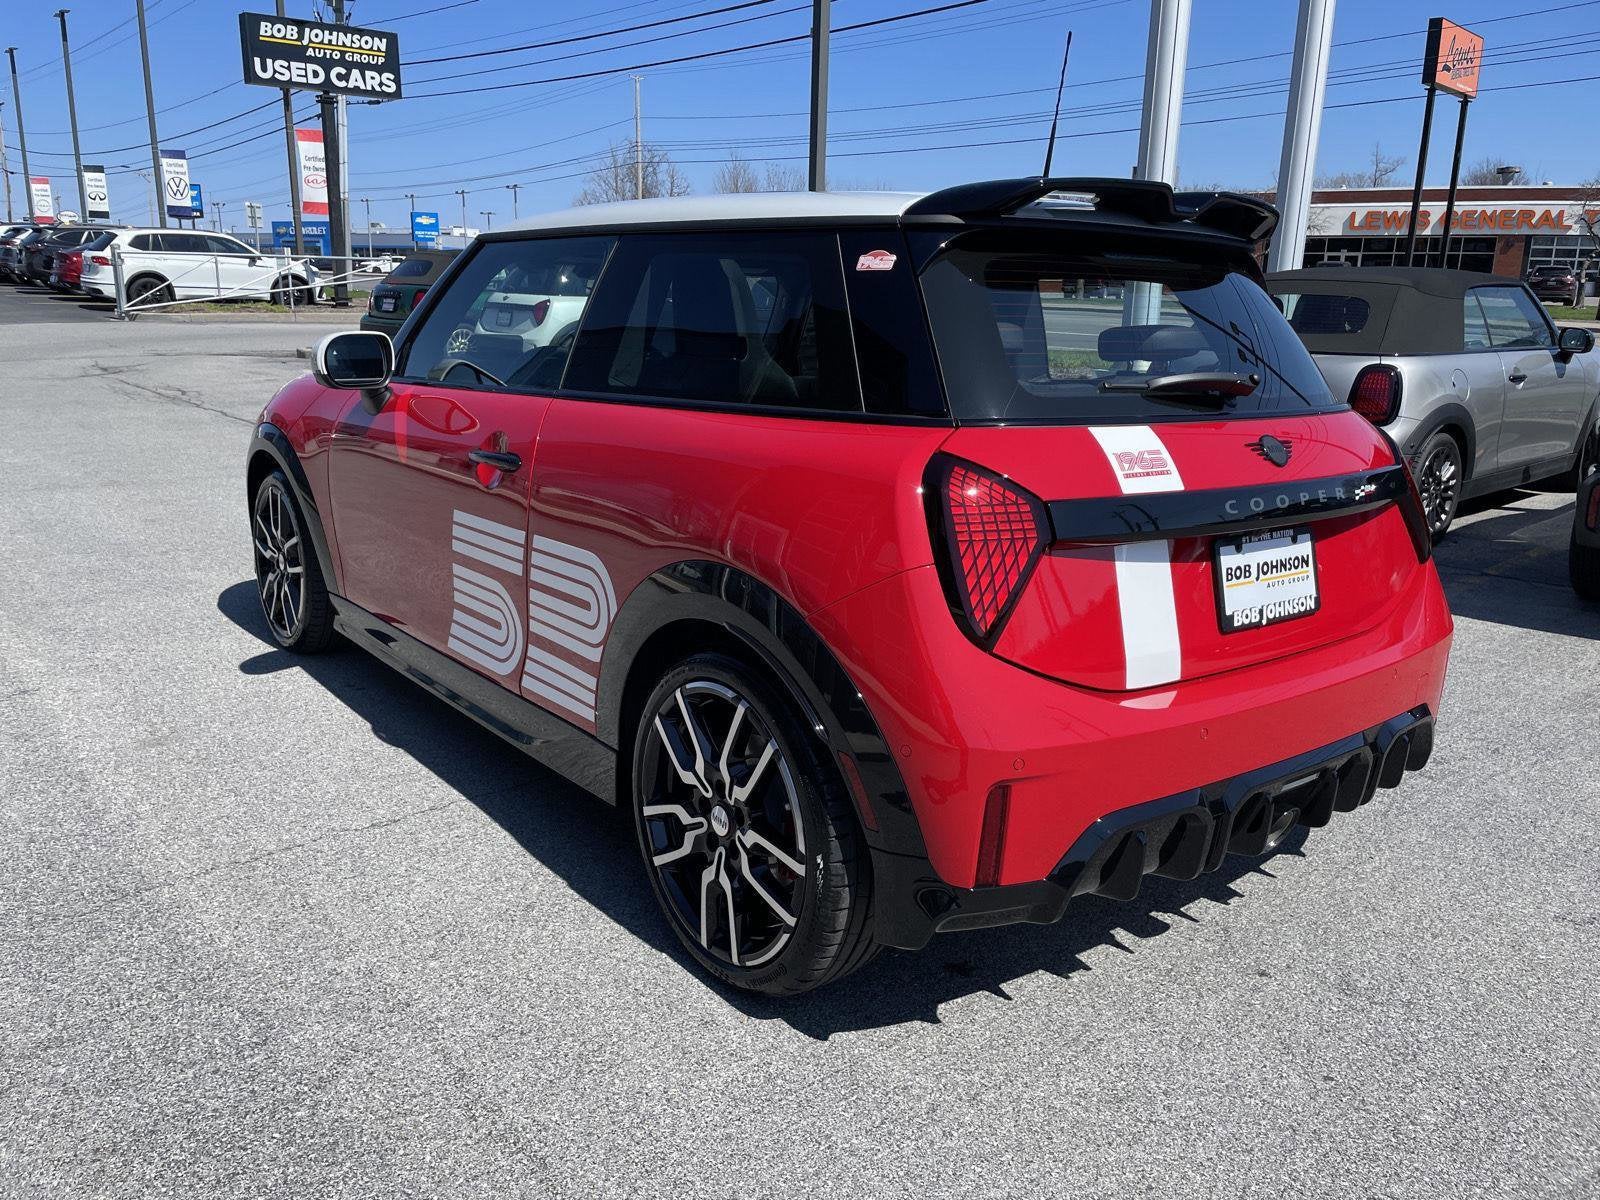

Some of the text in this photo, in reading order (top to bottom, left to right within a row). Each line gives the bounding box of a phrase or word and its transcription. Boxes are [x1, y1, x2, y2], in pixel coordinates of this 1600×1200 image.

[259, 21, 387, 52] BOB JOHNSON
[305, 47, 386, 66] AUTO GROUP
[253, 56, 397, 93] USED CARS
[303, 164, 326, 172] Pre-Owne
[289, 226, 327, 235] CVROLET
[1439, 209, 1573, 231] GENERAL
[1112, 449, 1168, 472] 1965
[1224, 487, 1346, 514] COOPER
[1272, 528, 1294, 539] NATION
[1225, 554, 1310, 582] BOB JOHNSON
[1266, 574, 1310, 589] AUTO GROUP
[1233, 594, 1317, 627] BOB JOHNSON
